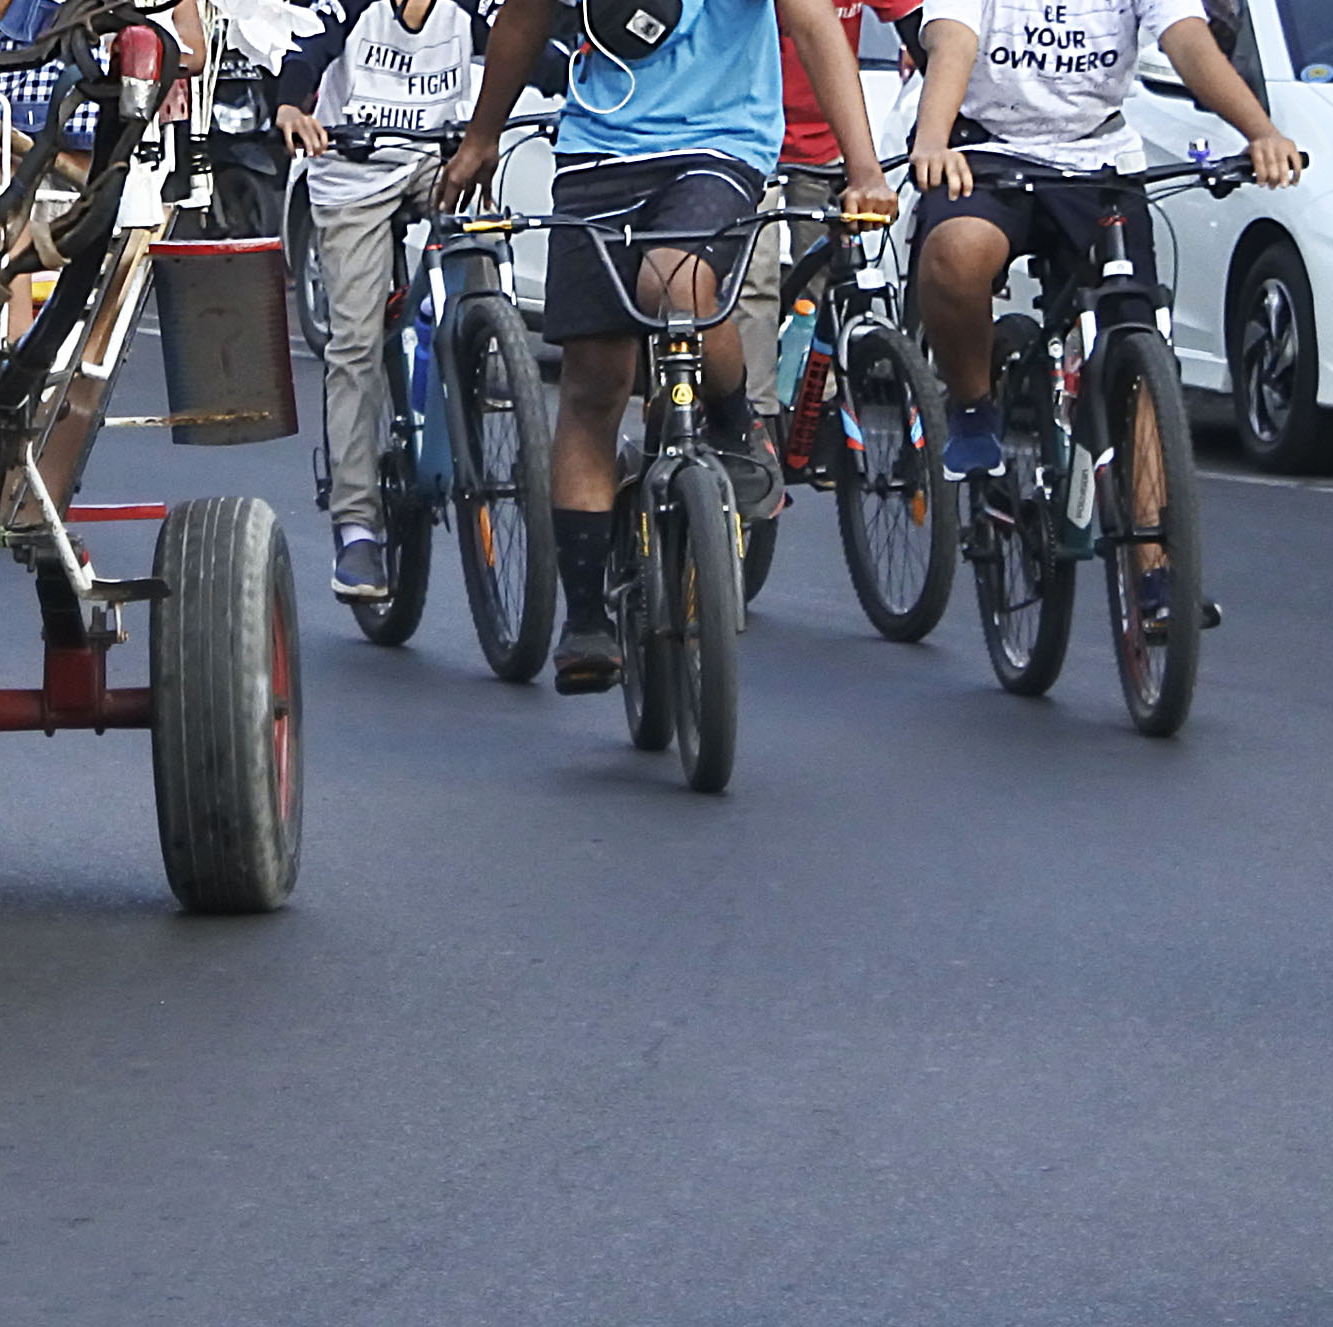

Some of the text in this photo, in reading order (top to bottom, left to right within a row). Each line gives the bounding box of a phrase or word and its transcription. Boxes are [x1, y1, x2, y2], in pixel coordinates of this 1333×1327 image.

[1044, 5, 1068, 24] BE
[1024, 25, 1086, 50] YOUR
[990, 46, 1119, 73] OWN HERO
[408, 68, 458, 95] FIGHT
[365, 106, 427, 132] HINE
